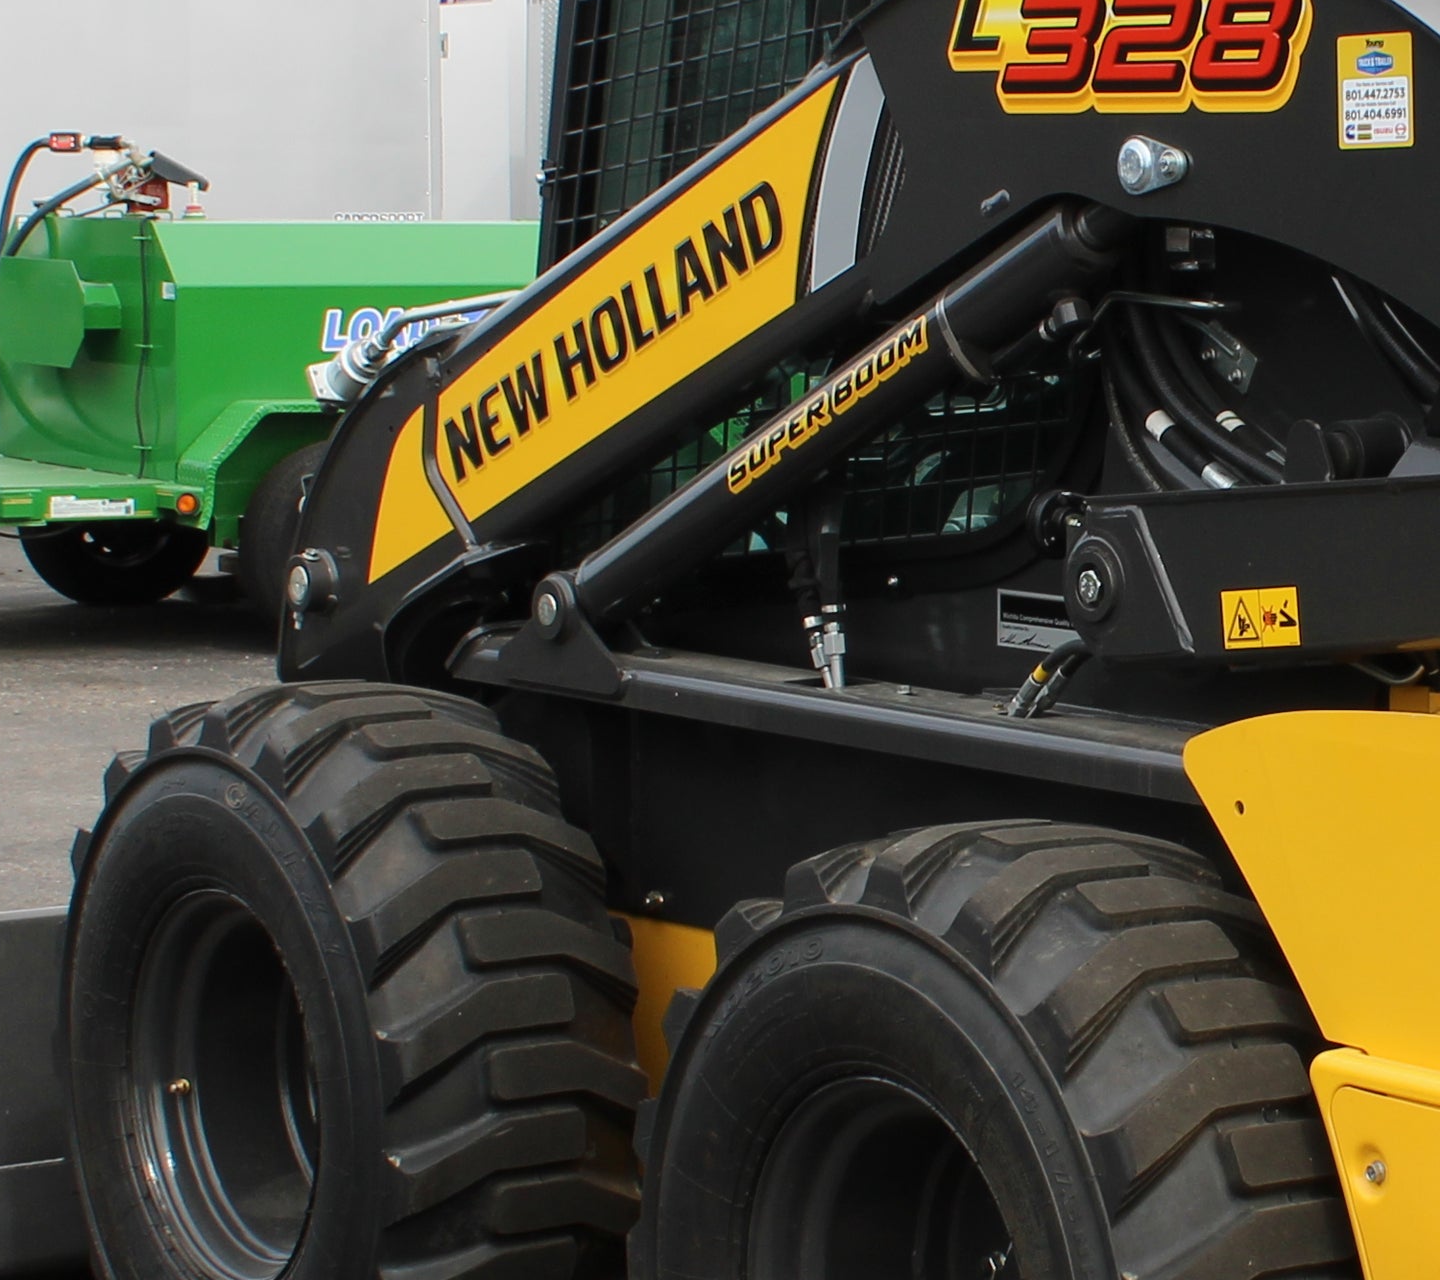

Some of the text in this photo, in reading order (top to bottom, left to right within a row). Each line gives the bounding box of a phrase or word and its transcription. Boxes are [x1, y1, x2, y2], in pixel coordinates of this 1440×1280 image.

[1344, 107, 1407, 121] 801.404.6991
[1345, 86, 1406, 101] 801.447.2753
[442, 180, 783, 486] NEW HOLLAND
[728, 315, 929, 495] SUPER BOOM
